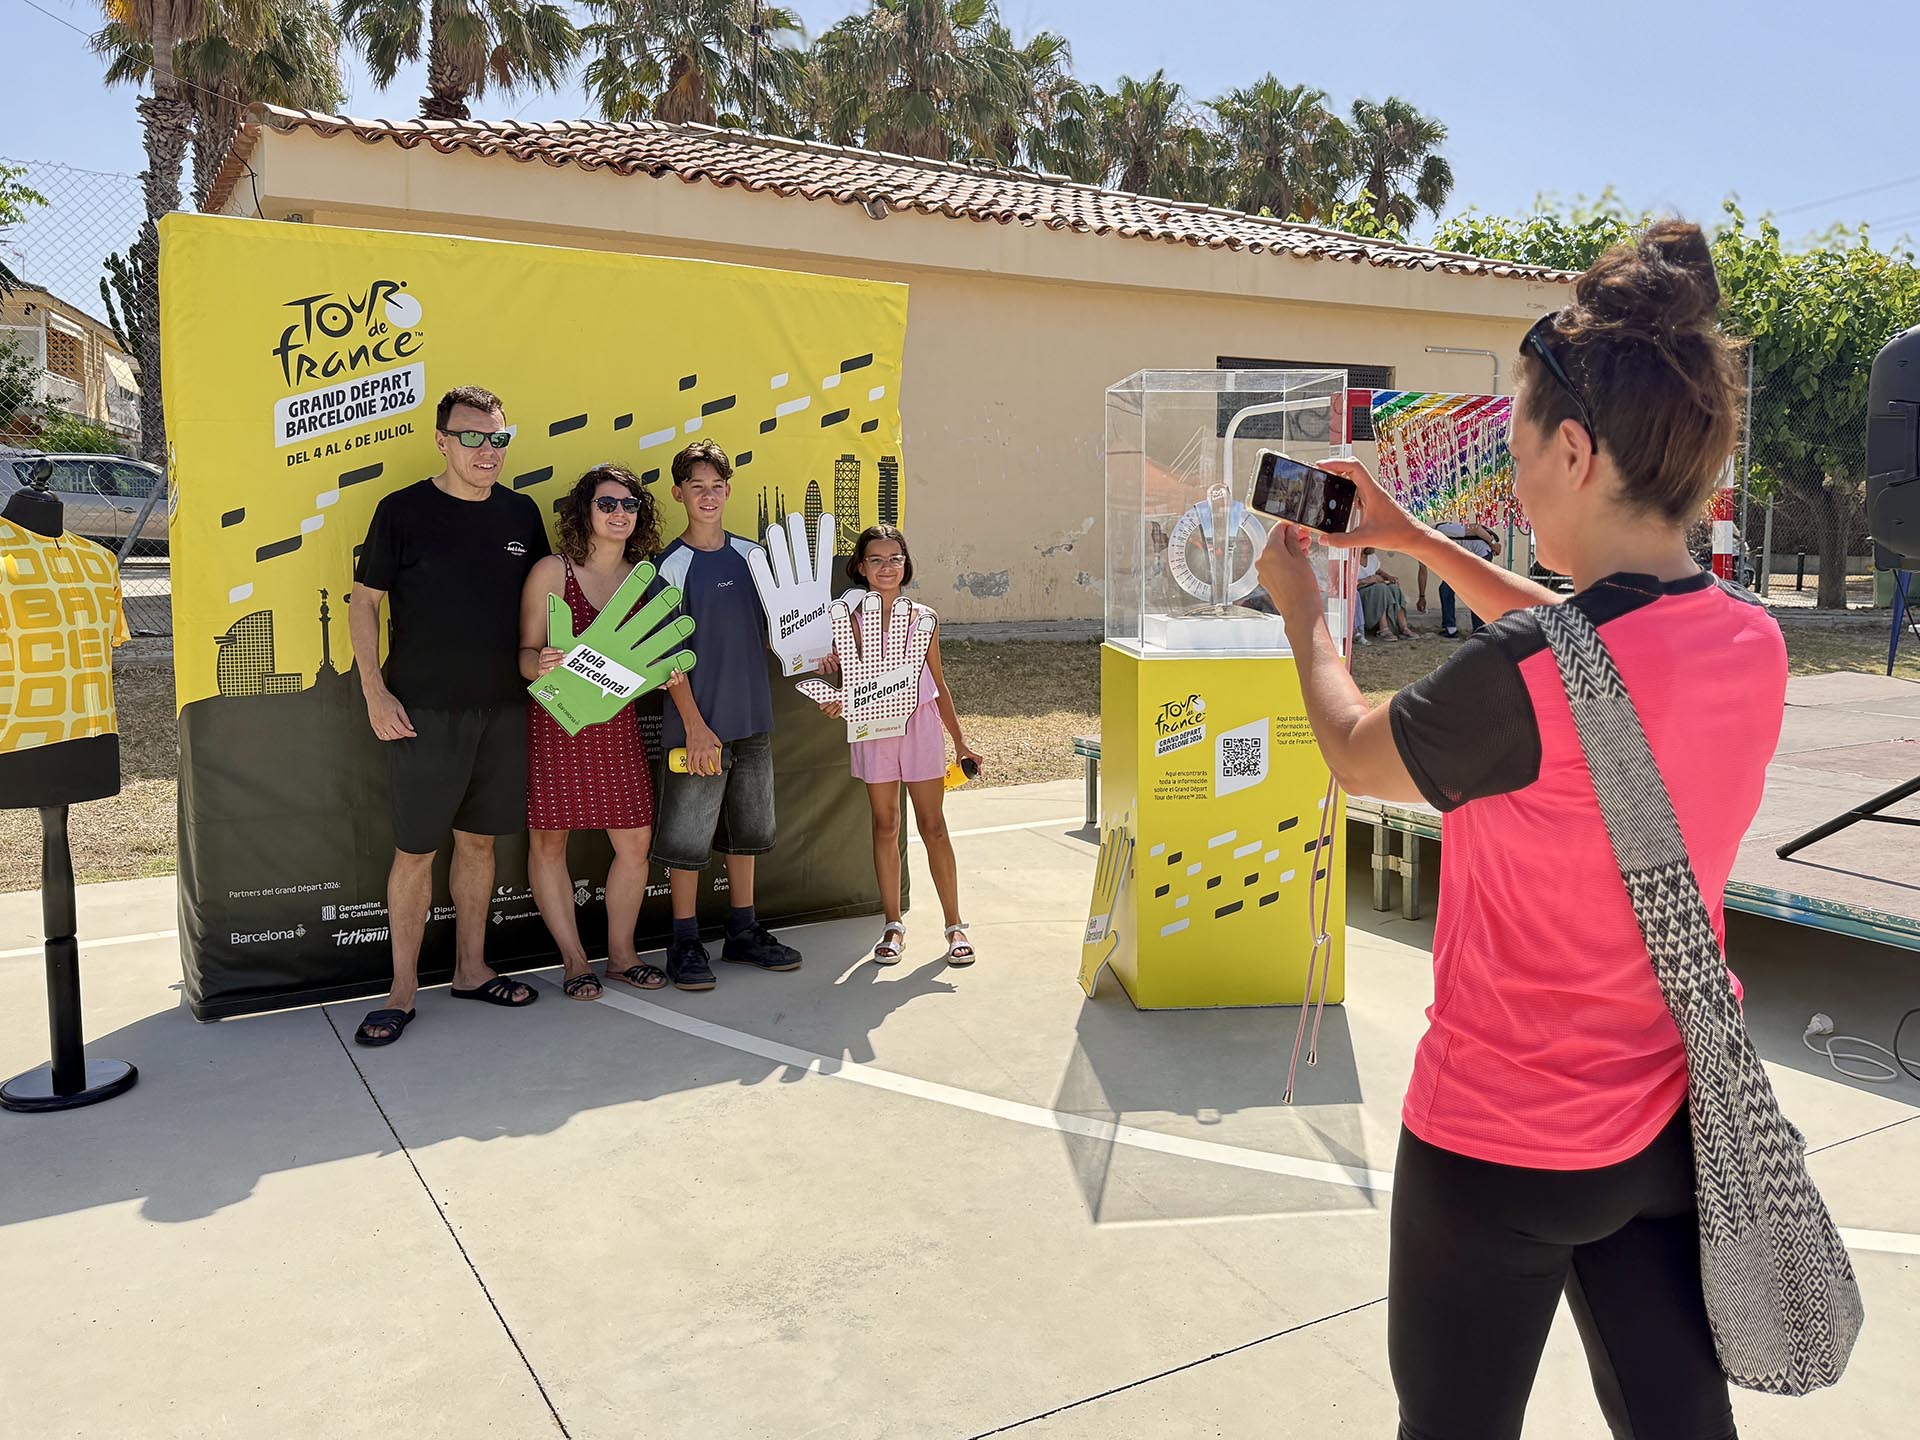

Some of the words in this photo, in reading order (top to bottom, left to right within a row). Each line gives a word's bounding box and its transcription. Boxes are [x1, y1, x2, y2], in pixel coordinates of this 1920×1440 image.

[368, 318, 388, 337] de
[288, 390, 346, 418] GRAND
[350, 371, 412, 402] DÉPART
[286, 400, 377, 438] BARCELONE
[380, 388, 416, 412] 2026
[287, 451, 310, 466] DEL
[313, 447, 322, 459] 4
[325, 443, 341, 456] AL
[344, 439, 352, 450] 6
[355, 434, 371, 448] DE
[373, 423, 415, 443] JULIOL
[779, 607, 800, 628] Hola
[780, 603, 826, 640] Barcelona!
[577, 648, 606, 668] Hola
[566, 657, 630, 696] Barcelona!
[854, 681, 878, 698] Hola
[854, 677, 909, 708] Barcelona!
[1158, 738, 1189, 754] BARCELONE
[1190, 734, 1202, 743] 2026
[1159, 735, 1180, 747] GRAND
[229, 890, 261, 898] Partners
[262, 888, 274, 896] del
[275, 886, 297, 895] Grand
[298, 883, 322, 893] Départ
[323, 881, 341, 890] 2026:
[339, 902, 381, 912] Generalitat
[351, 908, 388, 918] Catalunya
[231, 930, 295, 945] Barcelona
